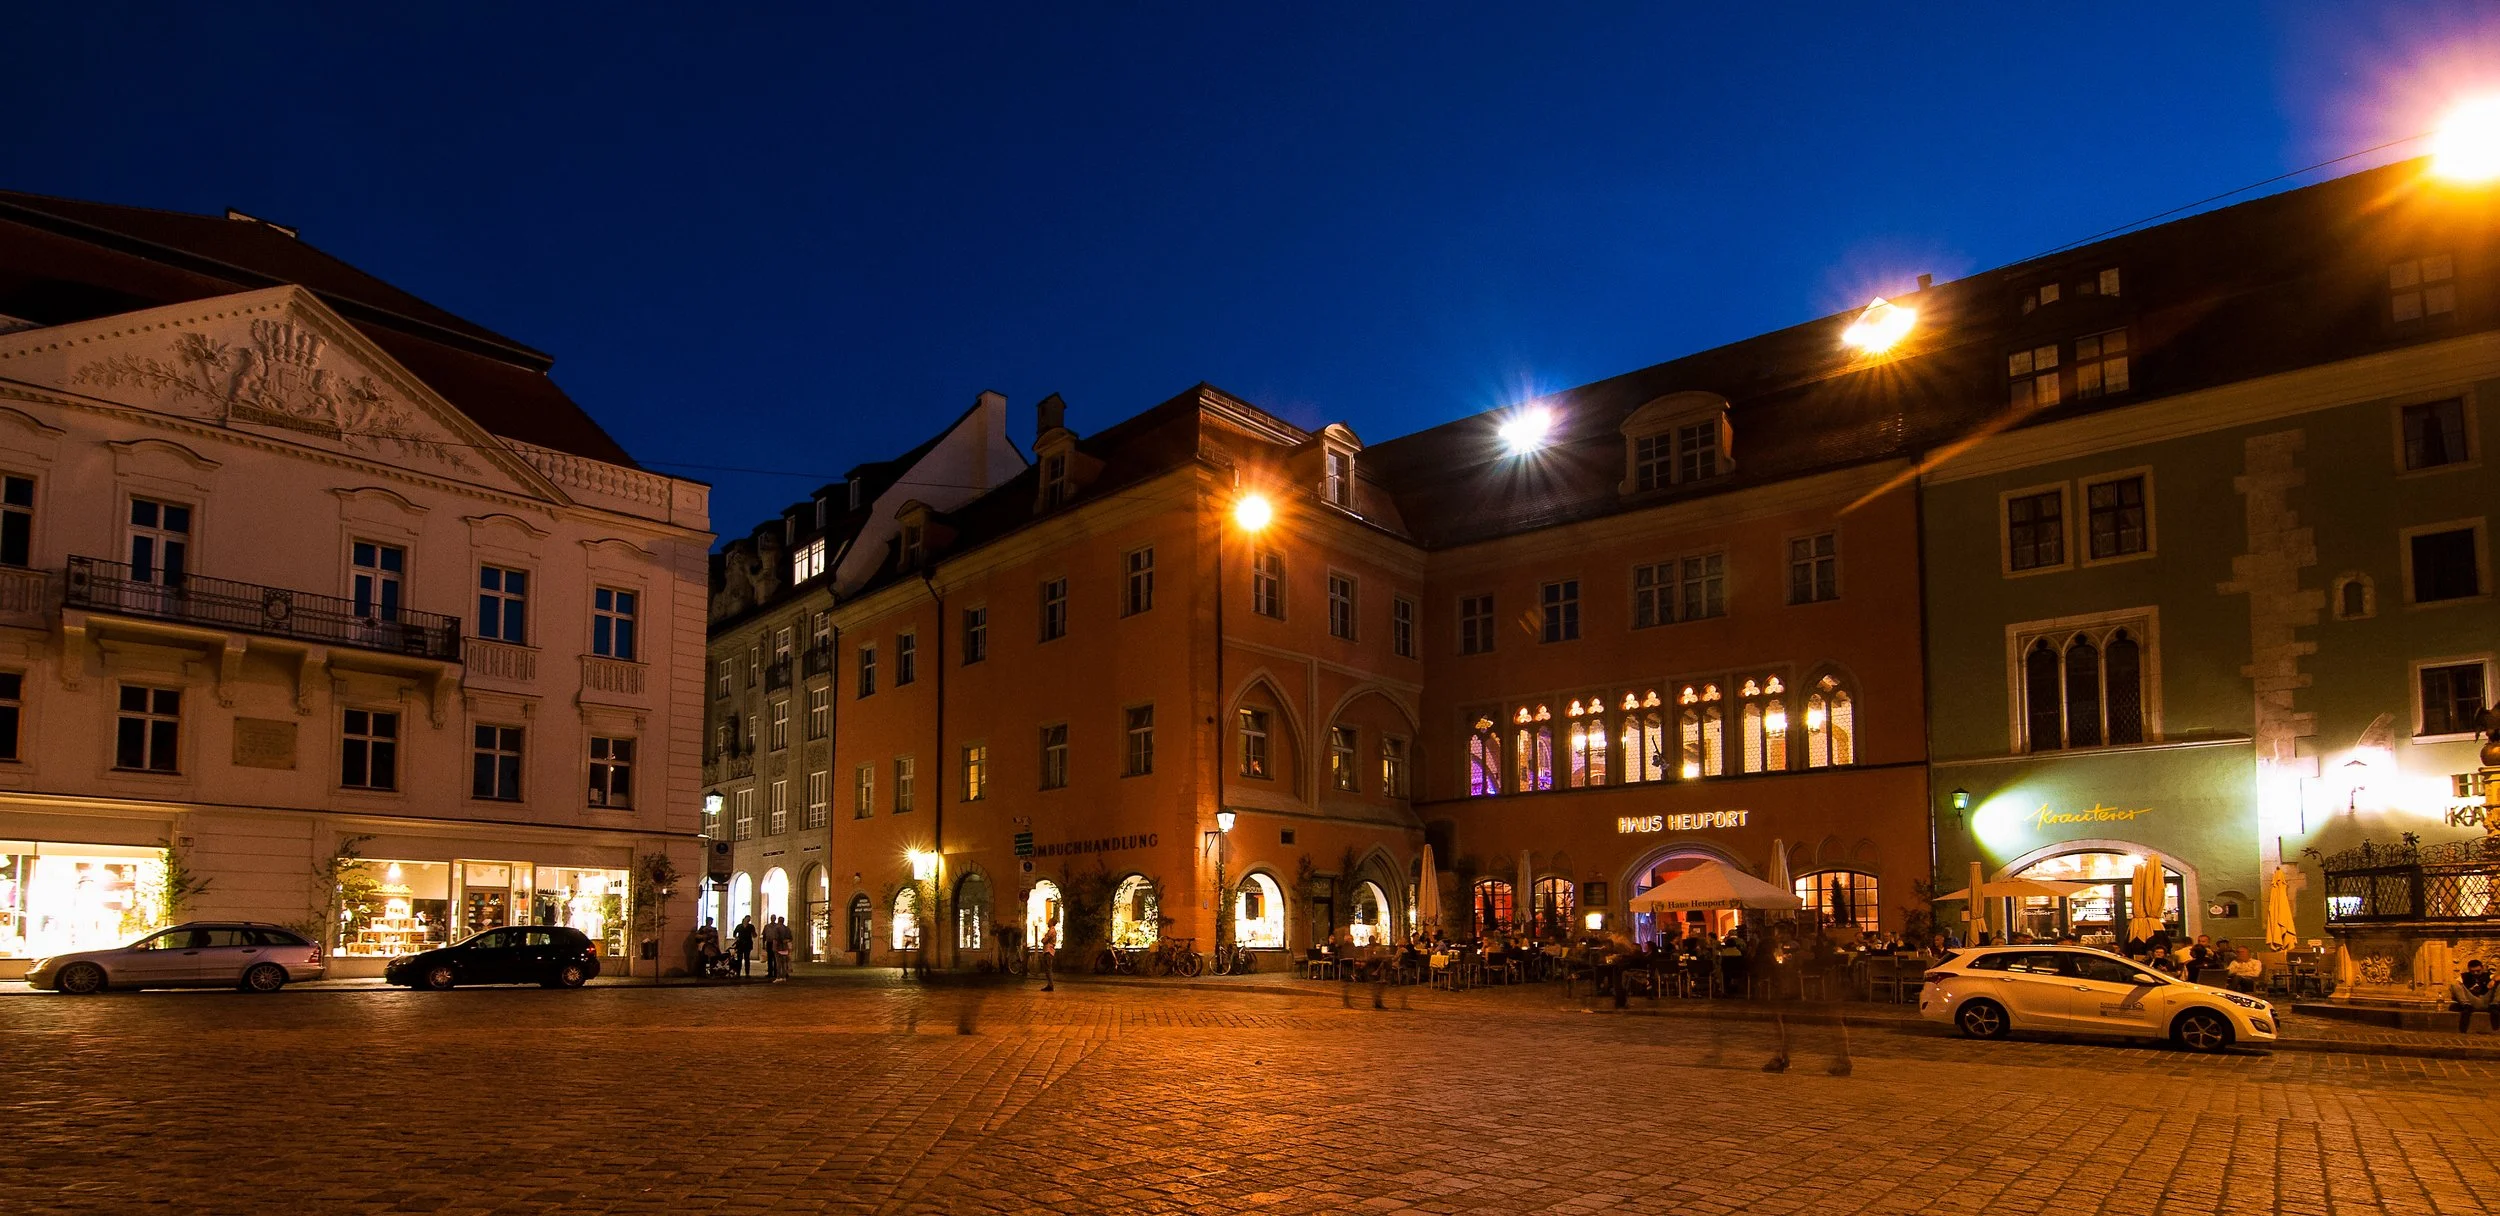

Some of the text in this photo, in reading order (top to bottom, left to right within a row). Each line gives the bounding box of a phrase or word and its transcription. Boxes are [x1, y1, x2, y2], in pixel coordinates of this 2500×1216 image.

[1617, 809, 1749, 834] HAUS HEUPORT
[1667, 899, 1726, 910] Haus Heuport
